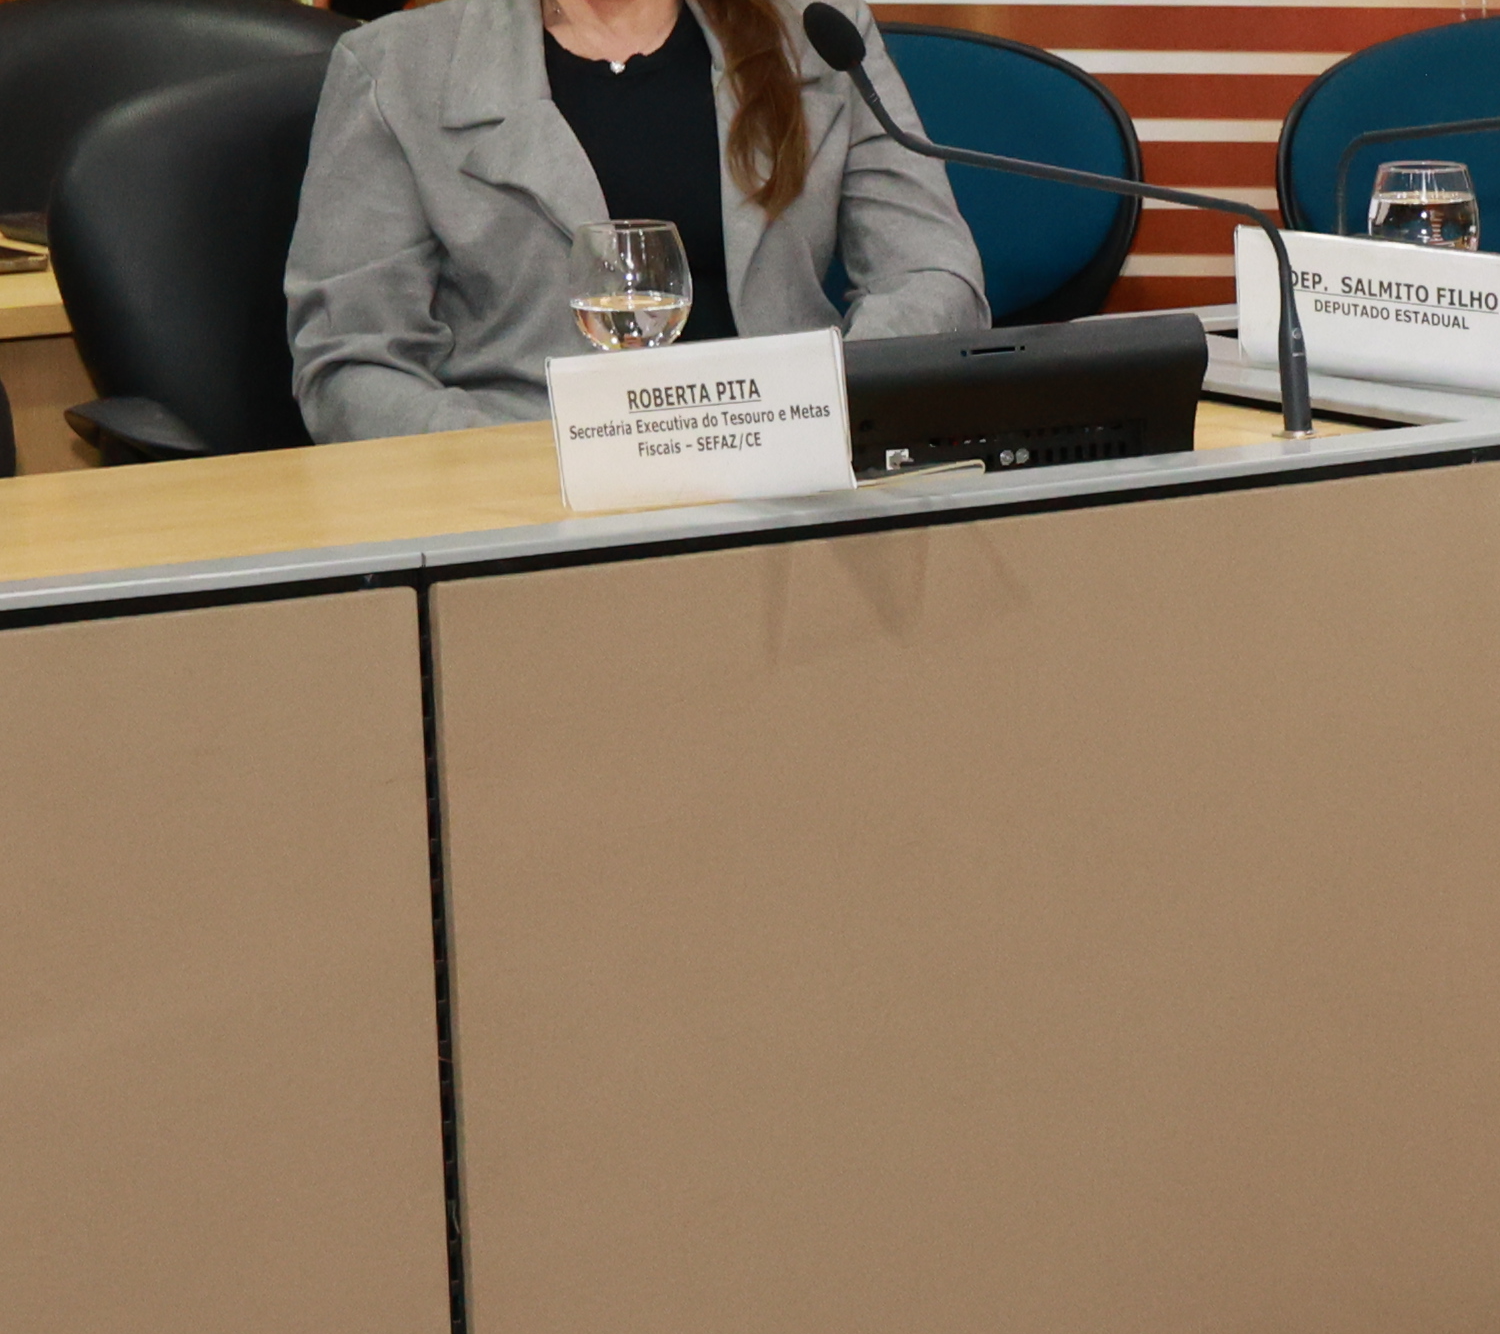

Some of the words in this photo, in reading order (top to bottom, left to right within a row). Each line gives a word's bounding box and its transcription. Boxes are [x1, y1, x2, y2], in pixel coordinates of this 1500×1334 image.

[1342, 277, 1428, 302] SALMITO
[1437, 287, 1498, 310] FILHO
[1315, 299, 1389, 320] DEPUTADO
[1395, 309, 1469, 329] ESTADUAL
[627, 384, 711, 409] ROBERTA
[716, 379, 760, 402] PITA
[570, 421, 632, 439] Secretária
[636, 416, 698, 433] Executiva
[702, 413, 718, 428] do
[721, 411, 774, 425] Tesouro
[779, 410, 786, 421] e
[790, 405, 830, 419] Metas
[638, 439, 681, 456] Fiscais
[697, 432, 761, 451] SEFAZ/CE
